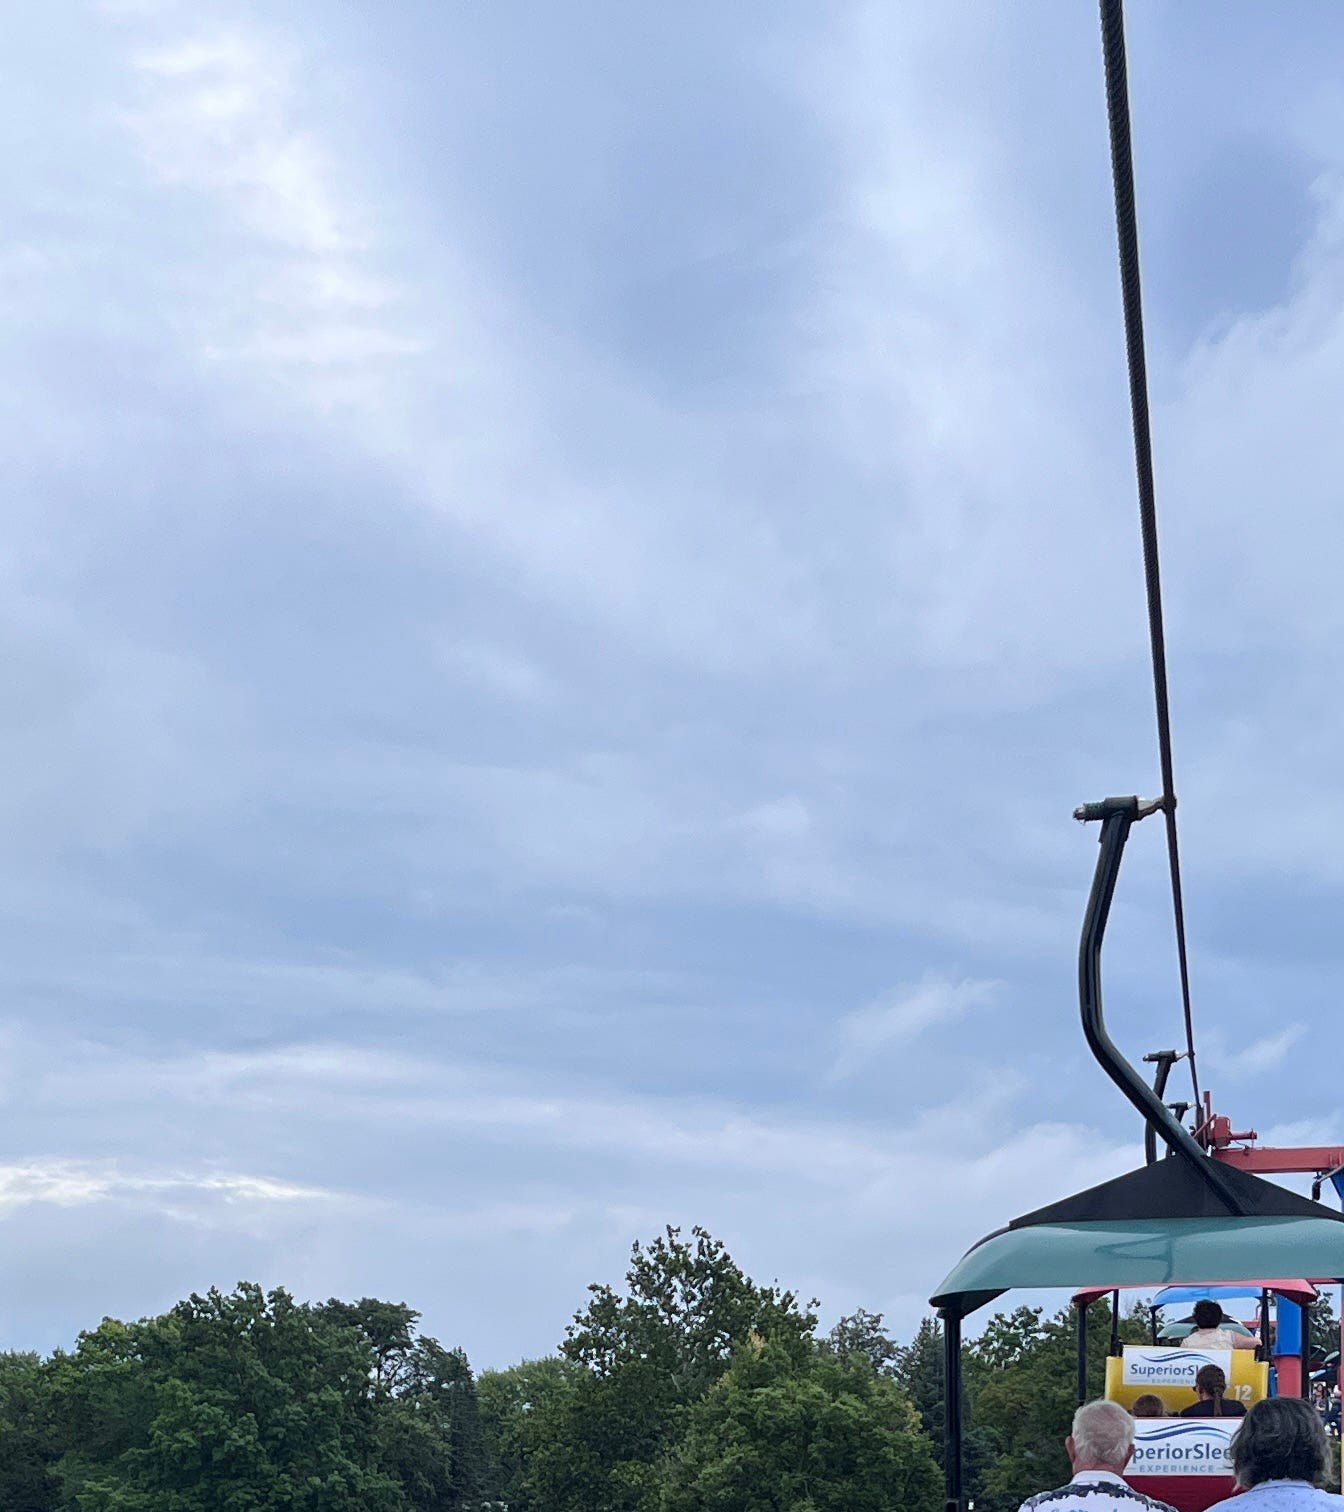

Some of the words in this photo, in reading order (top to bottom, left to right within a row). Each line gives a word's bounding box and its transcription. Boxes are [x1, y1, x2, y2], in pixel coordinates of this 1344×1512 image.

[1130, 1363, 1199, 1377] SuperiorSl
[1234, 1385, 1253, 1401] 12
[1132, 1443, 1233, 1464] periorSlee
[1139, 1464, 1215, 1473] EXPERIENCE
